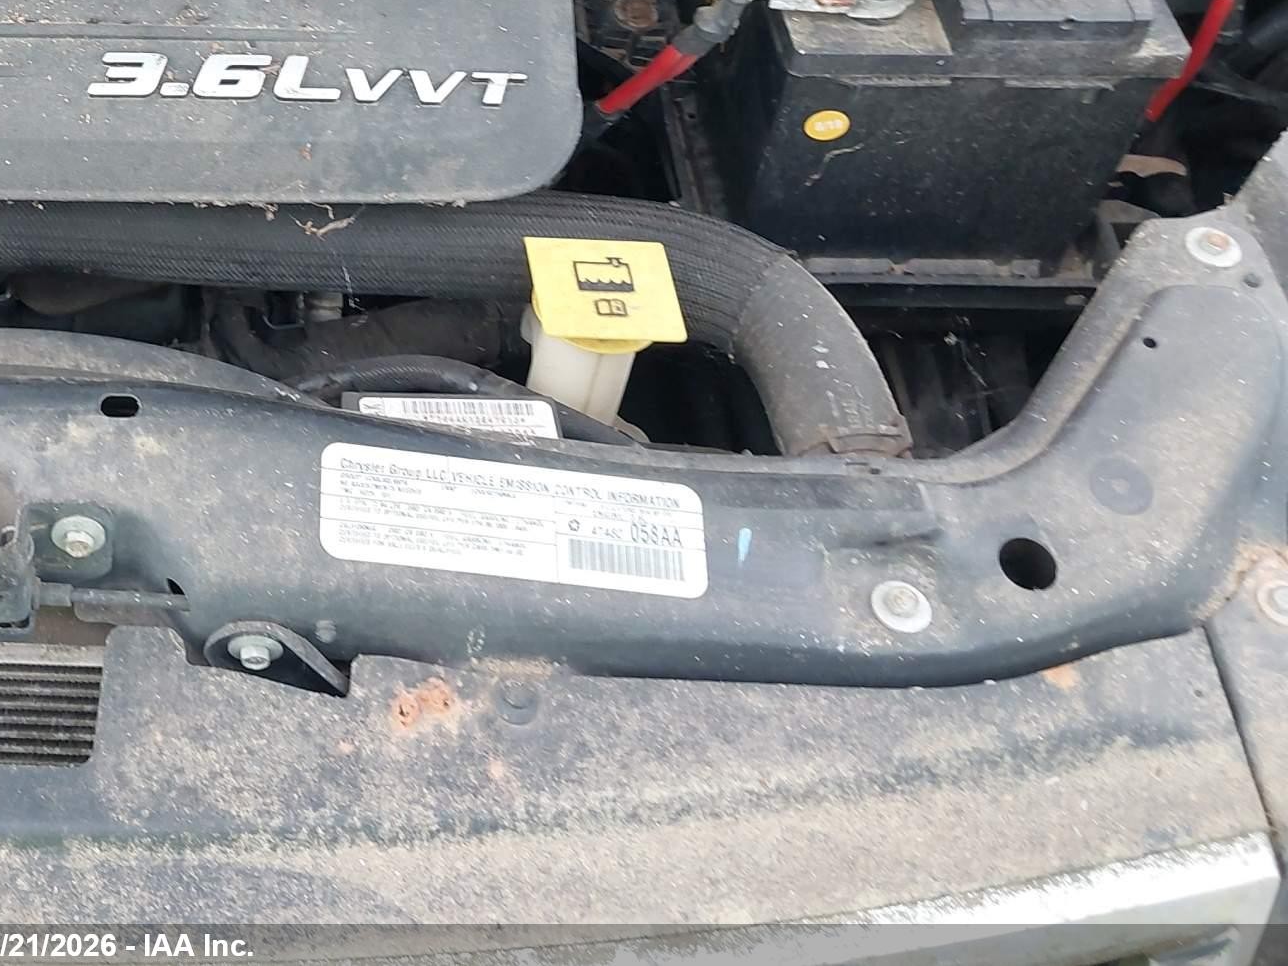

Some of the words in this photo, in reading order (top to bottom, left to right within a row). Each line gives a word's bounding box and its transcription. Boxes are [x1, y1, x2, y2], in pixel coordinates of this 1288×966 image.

[87, 52, 342, 102] 3.6L
[344, 67, 529, 106] VVT
[339, 457, 385, 474] Chrysler
[389, 463, 422, 480] Group
[425, 468, 446, 481] LLC
[451, 471, 495, 487] VEHICLE
[500, 476, 550, 493] EMISSION
[607, 490, 681, 509] INFORMATION
